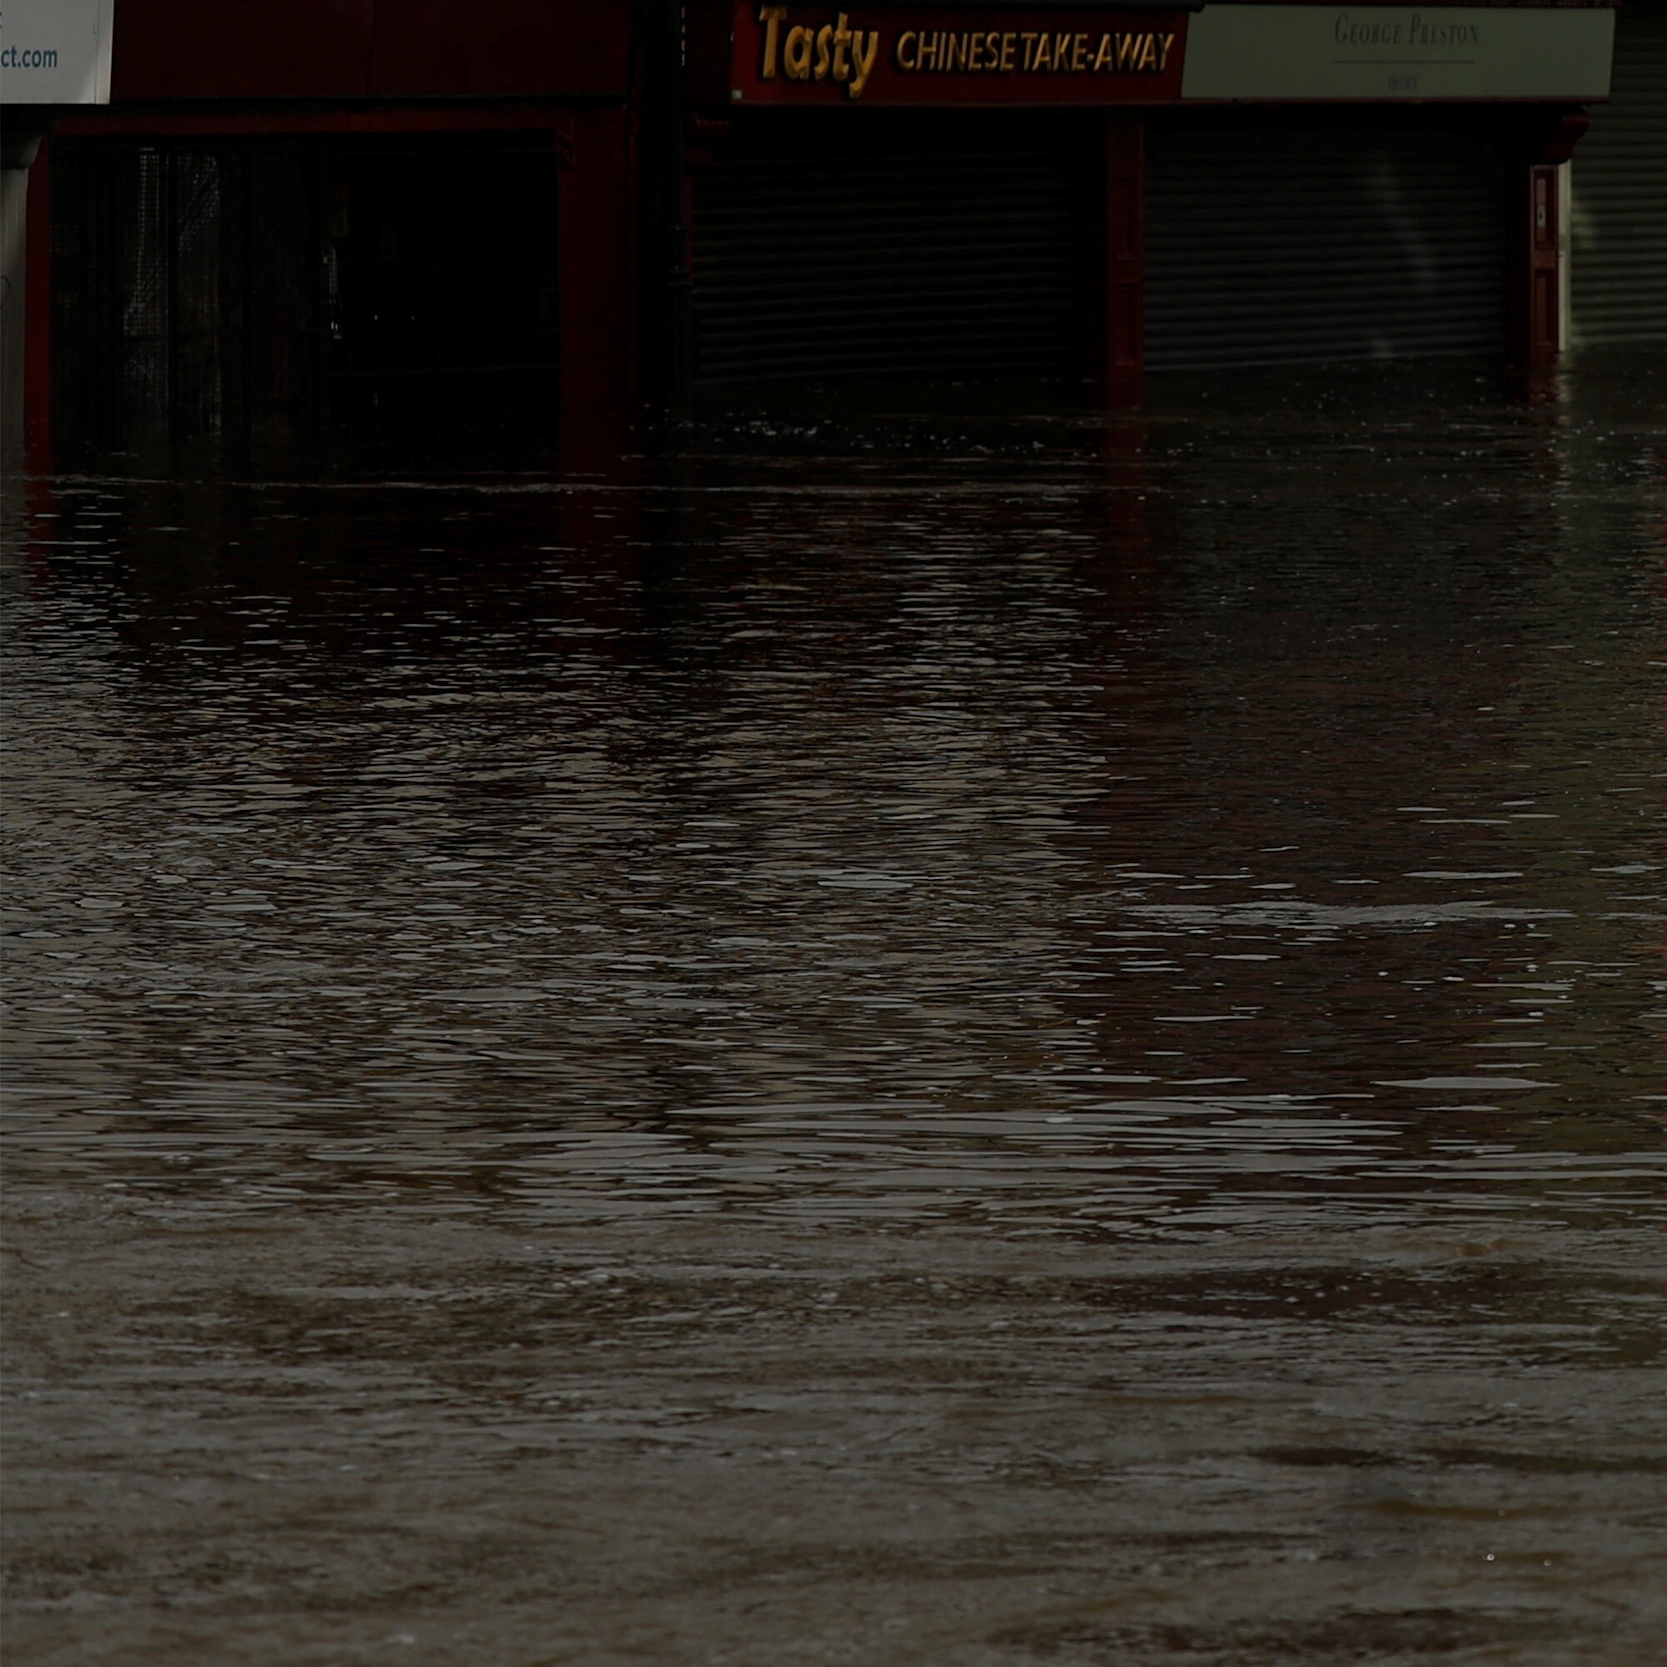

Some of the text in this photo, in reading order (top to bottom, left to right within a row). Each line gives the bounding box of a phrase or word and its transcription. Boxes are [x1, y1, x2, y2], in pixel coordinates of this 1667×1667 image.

[758, 4, 1177, 99] Tasty CHINESE TAKE-AWAY
